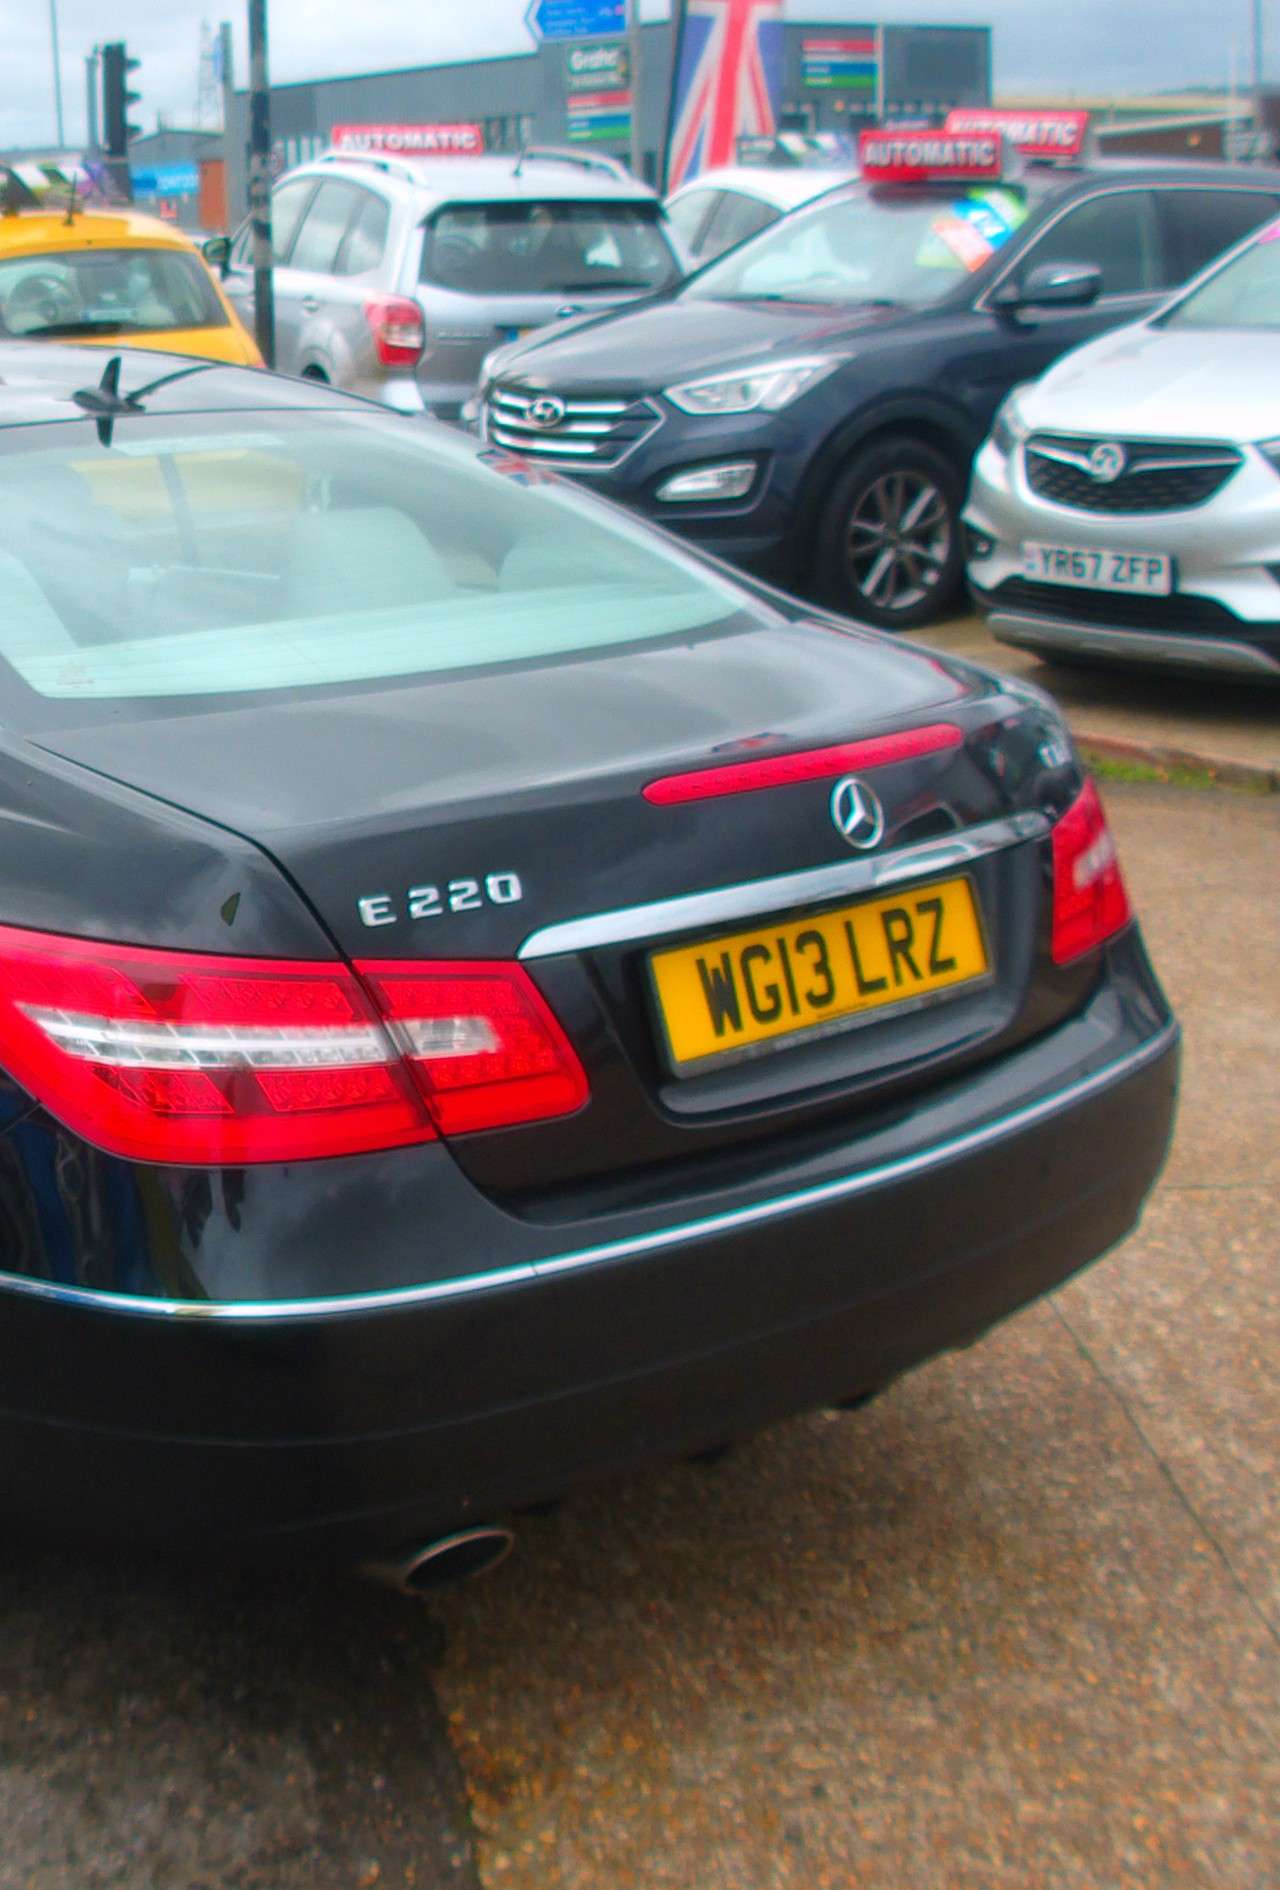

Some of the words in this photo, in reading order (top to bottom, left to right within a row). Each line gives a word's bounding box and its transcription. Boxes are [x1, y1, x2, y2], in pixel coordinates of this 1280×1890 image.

[340, 131, 478, 150] AUTOMATIC
[863, 140, 996, 168] AUTOMATIC
[1039, 549, 1103, 579] YR67
[1111, 555, 1163, 586] ZFP
[358, 895, 398, 927] E
[408, 871, 523, 919] 220
[696, 929, 836, 1038] WG13
[844, 897, 957, 997] LRZ
